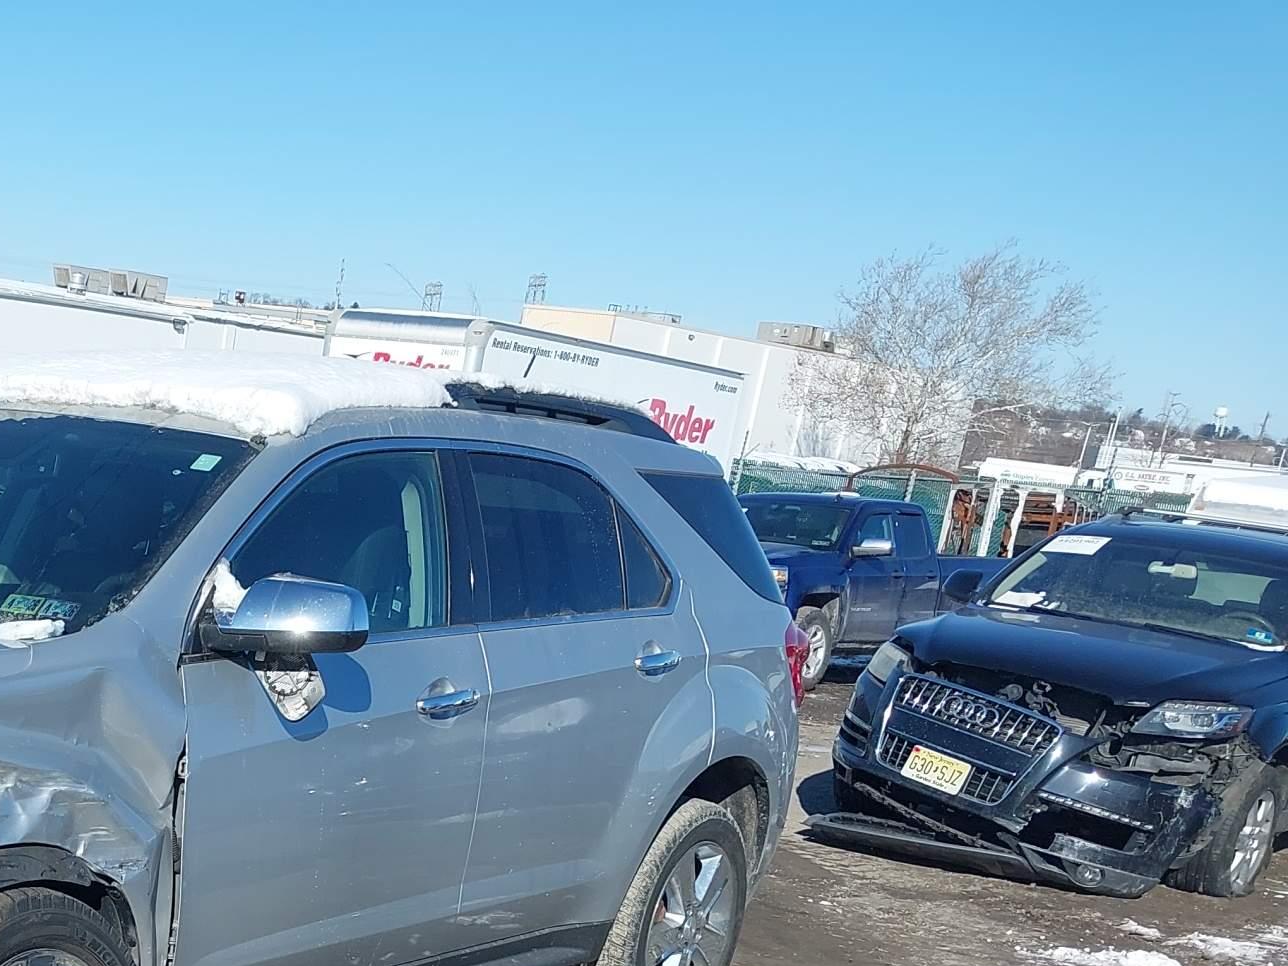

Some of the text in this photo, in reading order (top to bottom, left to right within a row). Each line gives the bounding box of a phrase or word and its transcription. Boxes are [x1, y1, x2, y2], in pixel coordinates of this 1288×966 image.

[491, 337, 600, 367] Rental Reservations: 1-800-BY-RYDER
[713, 381, 738, 394] Ryder.com
[649, 398, 716, 444] Ryder
